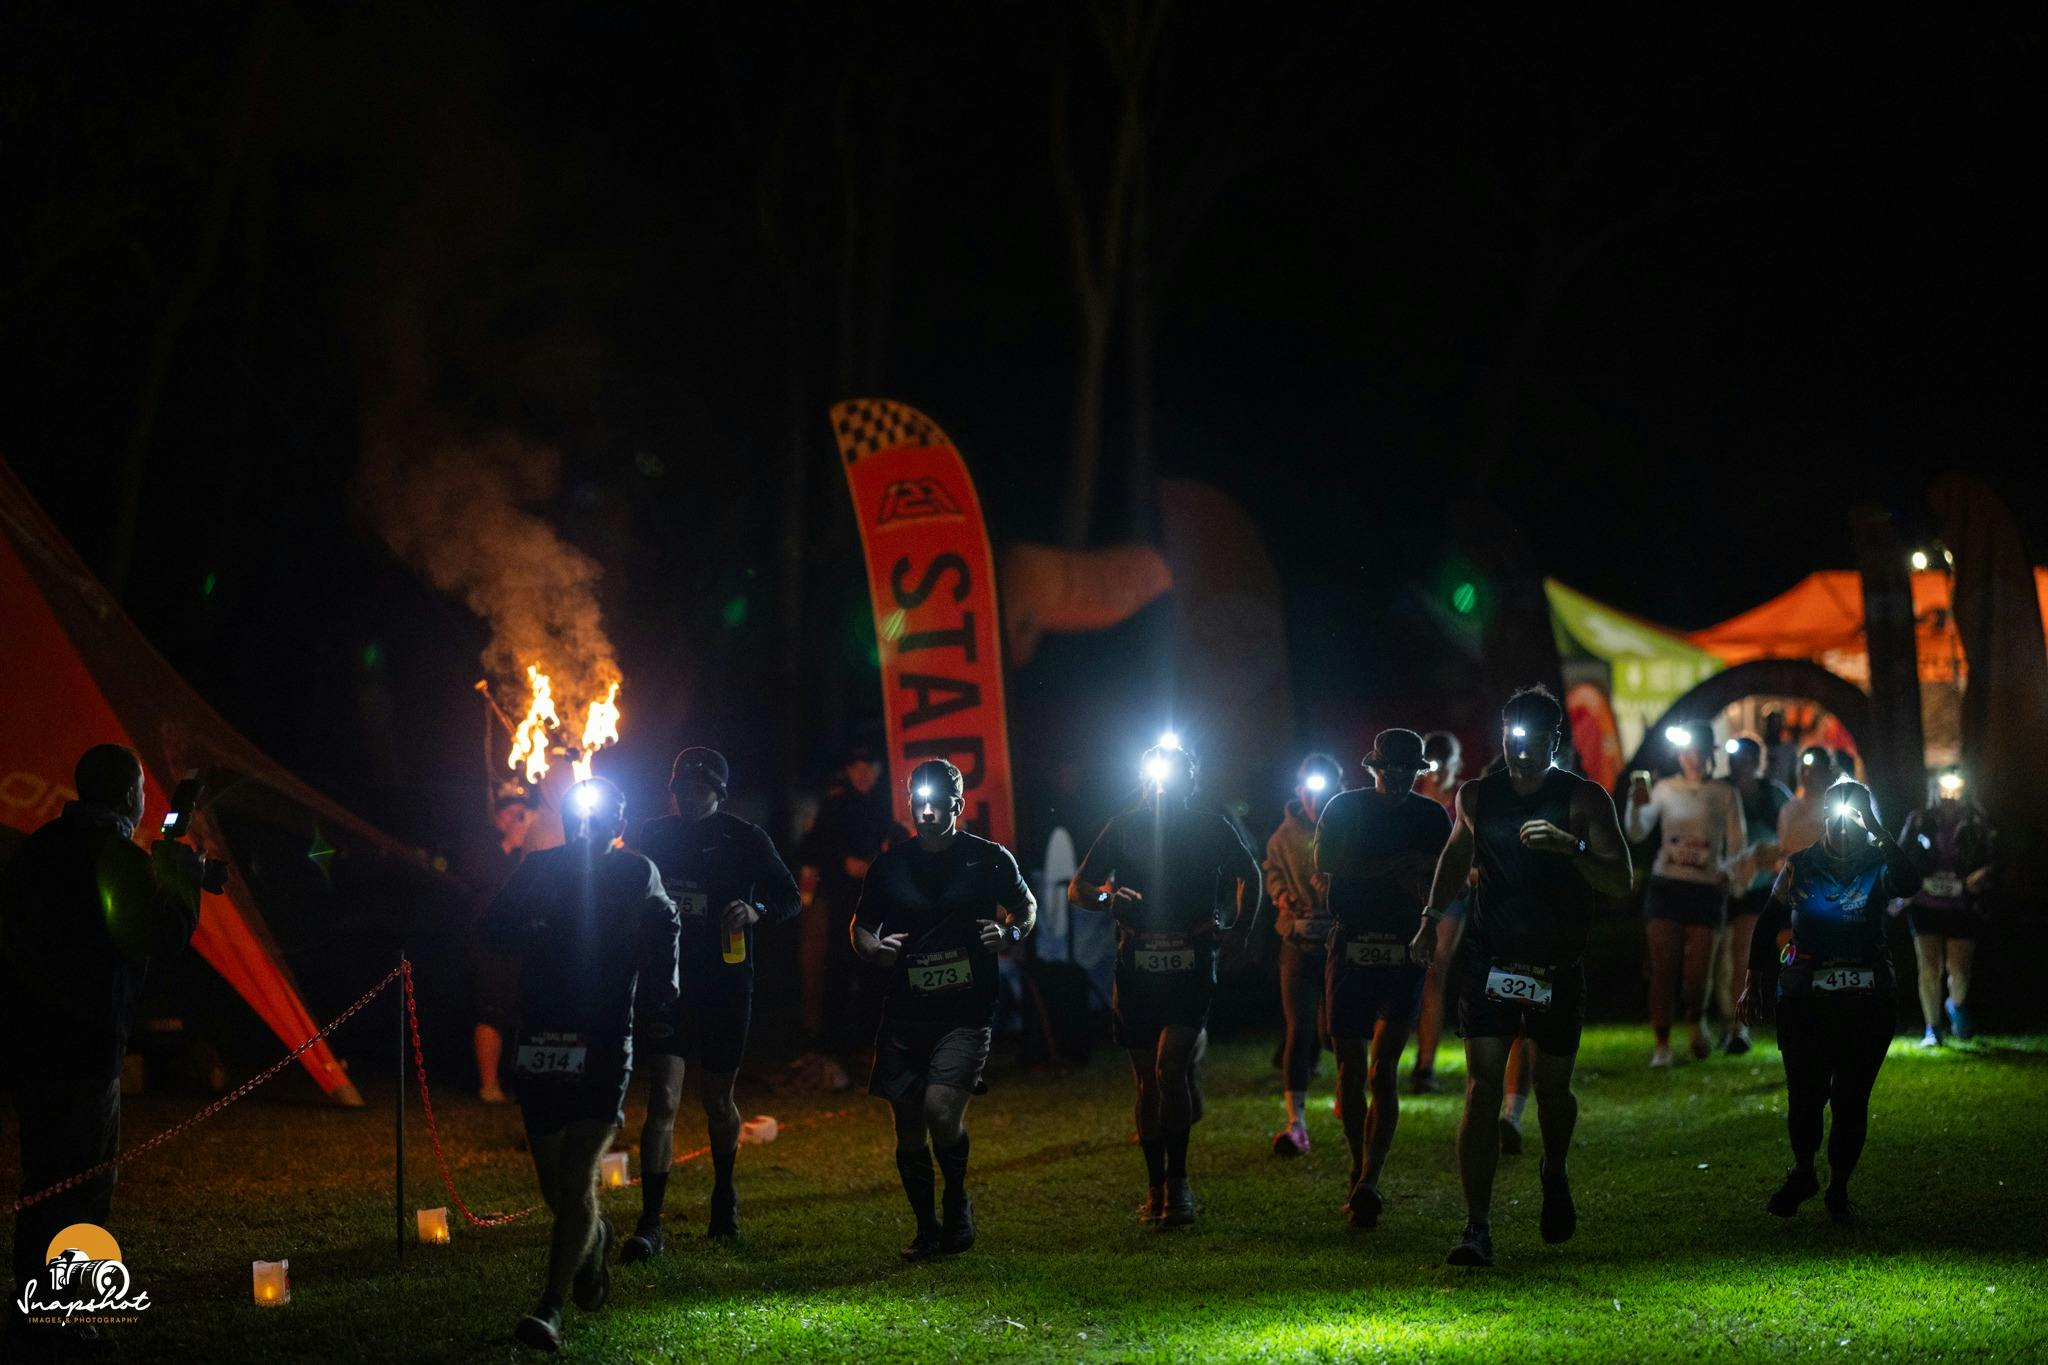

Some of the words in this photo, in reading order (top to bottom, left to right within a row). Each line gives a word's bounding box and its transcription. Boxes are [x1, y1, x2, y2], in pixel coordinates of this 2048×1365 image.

[891, 552, 989, 838] STAR
[1148, 955, 1182, 969] 316
[1360, 947, 1391, 962] 294
[922, 967, 958, 987] 273
[1826, 971, 1861, 988] 413
[1501, 978, 1536, 1000] 321
[531, 1052, 570, 1070] 314
